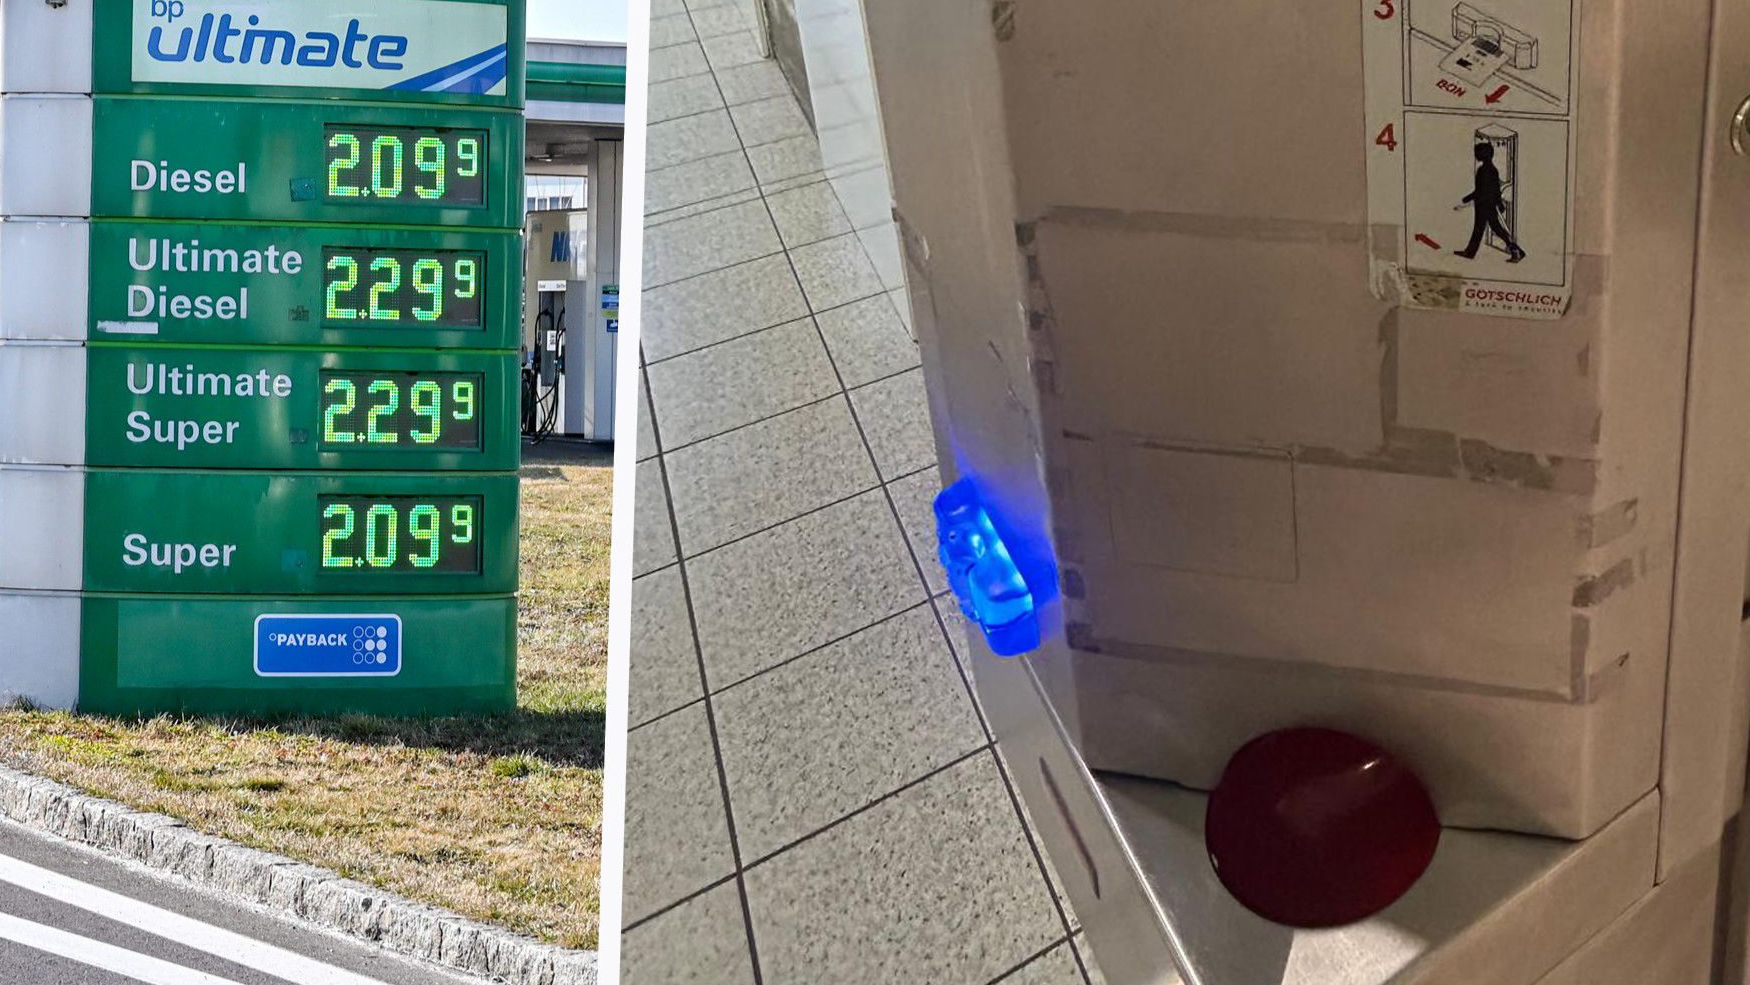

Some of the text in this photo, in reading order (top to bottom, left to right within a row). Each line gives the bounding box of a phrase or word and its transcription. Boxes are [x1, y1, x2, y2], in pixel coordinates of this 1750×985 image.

[147, 13, 409, 70] ultimate
[1436, 79, 1467, 98] BON
[1375, 123, 1398, 152] 4
[130, 160, 246, 194] Diesel
[128, 237, 303, 275] Ultimate
[127, 285, 248, 320] Diesel
[1465, 288, 1562, 306] GOTSCHLICH
[127, 362, 293, 397] Ultimate
[126, 410, 240, 451] Super
[122, 533, 237, 574] Super
[276, 633, 348, 647] PAYBACK
